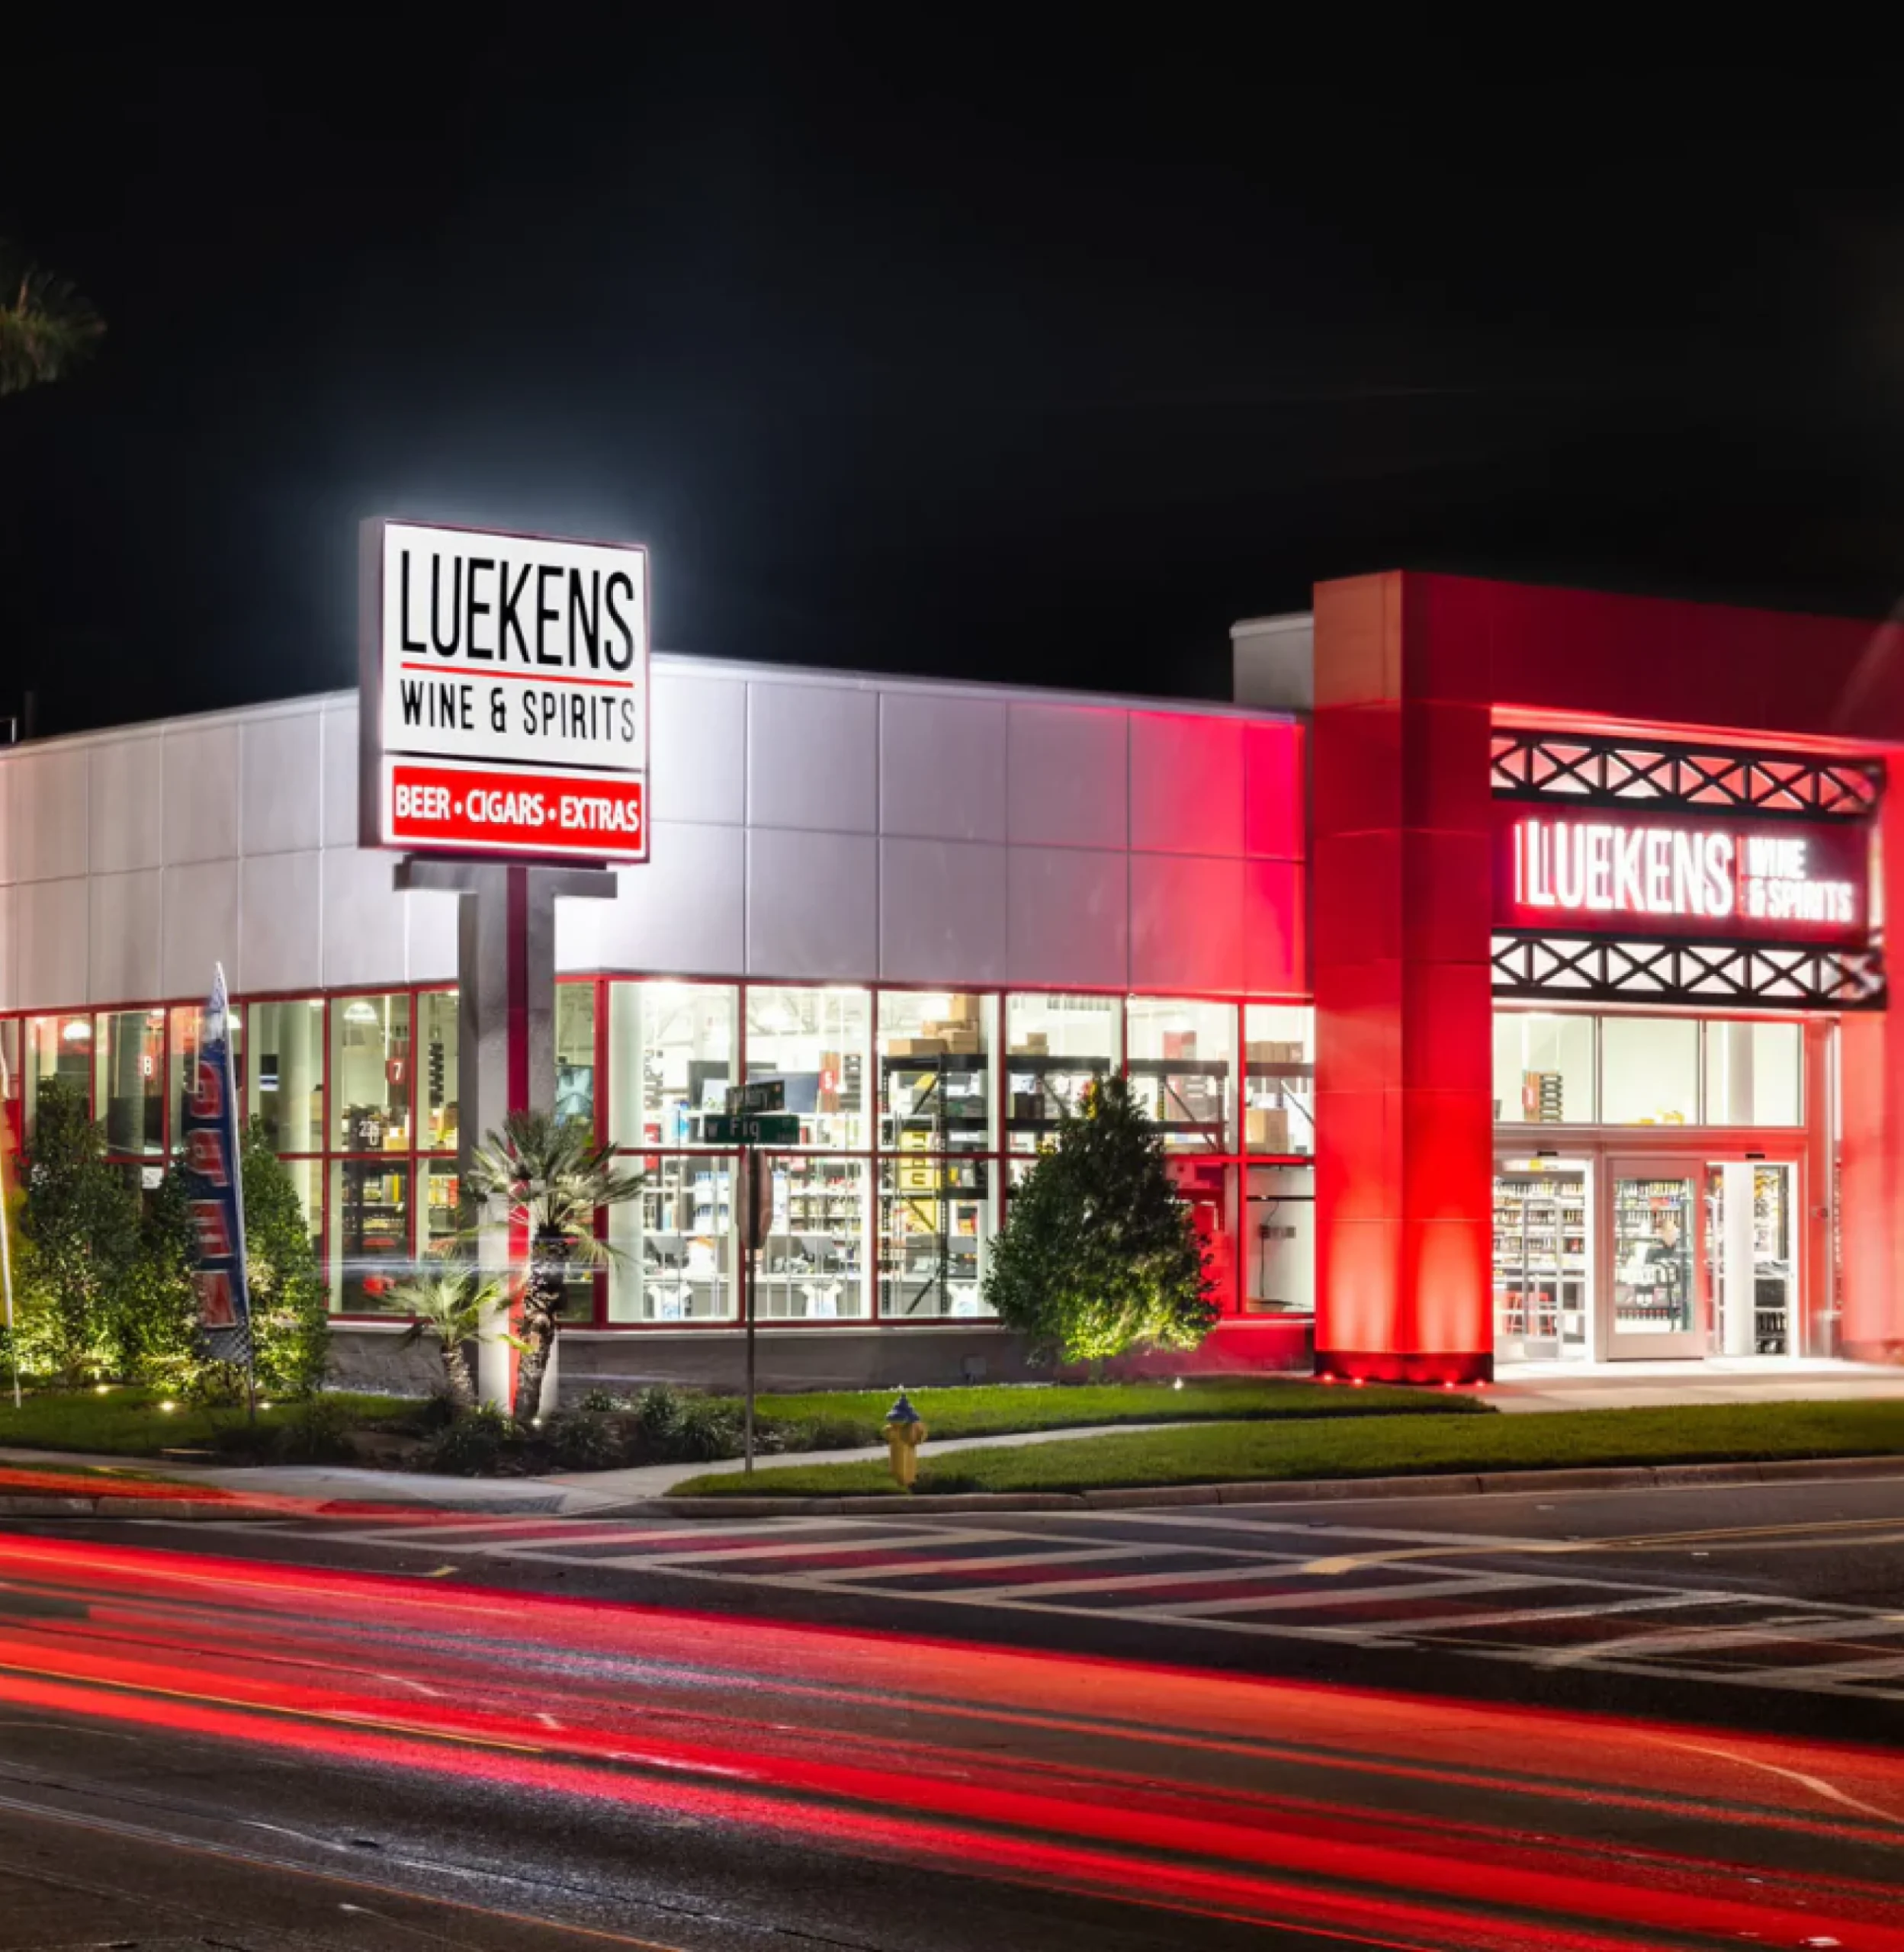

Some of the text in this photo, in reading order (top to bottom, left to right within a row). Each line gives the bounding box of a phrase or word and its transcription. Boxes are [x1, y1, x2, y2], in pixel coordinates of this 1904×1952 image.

[400, 550, 634, 672] LUEKENS
[400, 678, 635, 742] WINE & SPIRITS
[395, 784, 640, 833] BEER CIGARS EXTRAS
[1516, 820, 1735, 918] LUEKENS
[1766, 881, 1854, 923] SPIRITS
[729, 1117, 761, 1142] Fig
